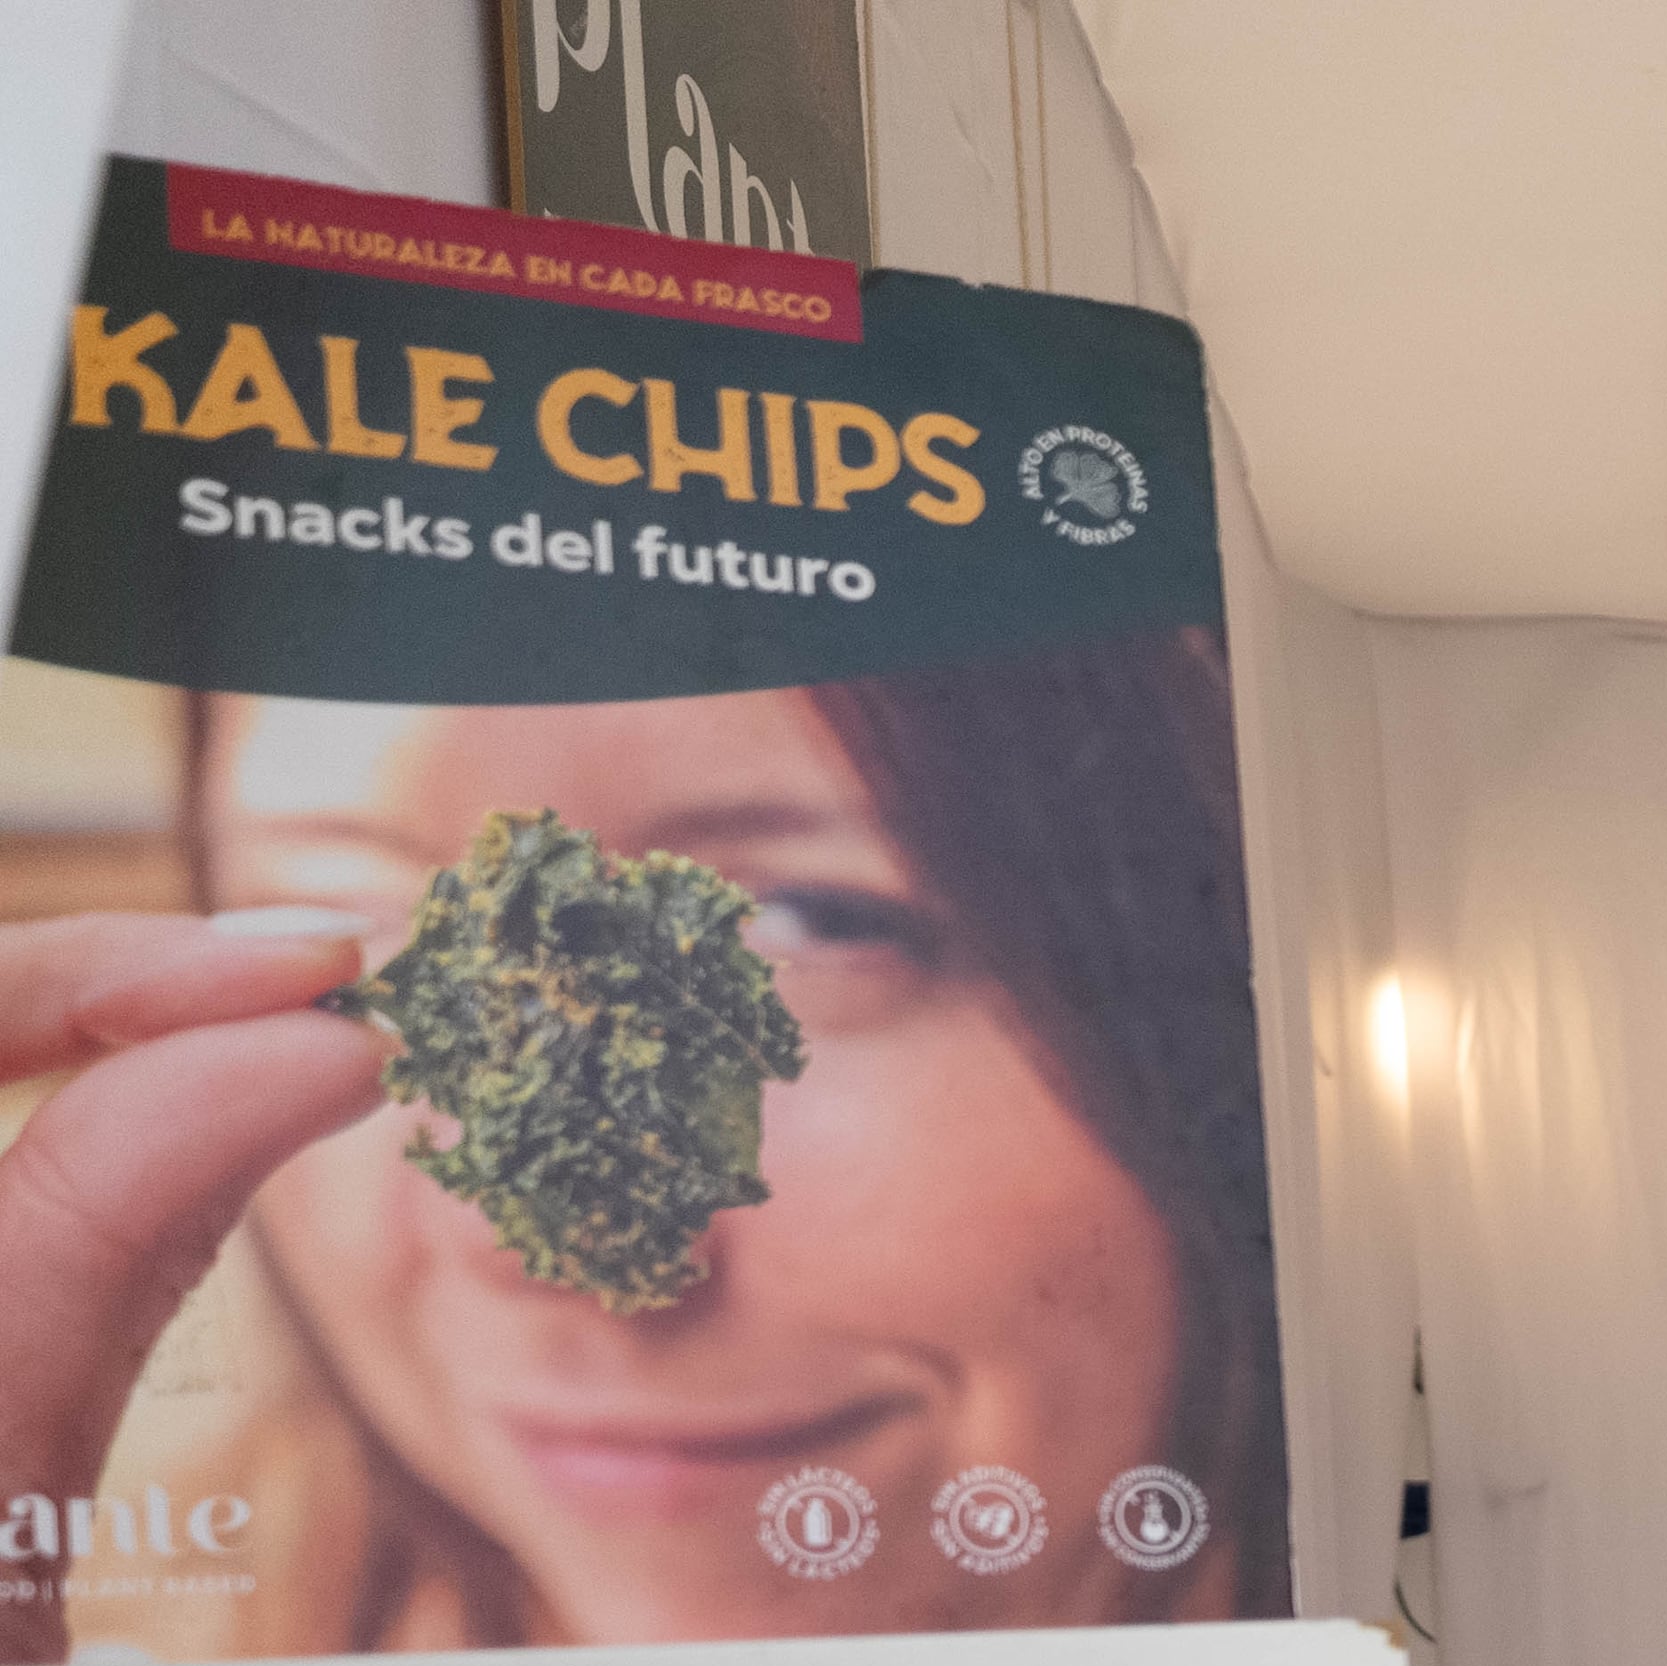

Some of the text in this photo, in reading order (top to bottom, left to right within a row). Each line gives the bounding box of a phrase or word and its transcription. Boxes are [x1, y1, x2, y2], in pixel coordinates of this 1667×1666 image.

[203, 209, 832, 325] LA NATURALEZA EN CADA FRASCO
[69, 305, 986, 526] KALE CHIPS
[1018, 425, 1149, 514] ALTO EN PROTEINAS
[179, 478, 875, 602] Snacks del futuro
[1042, 509, 1136, 546] Y FIBRAS
[0, 1483, 252, 1559] ante
